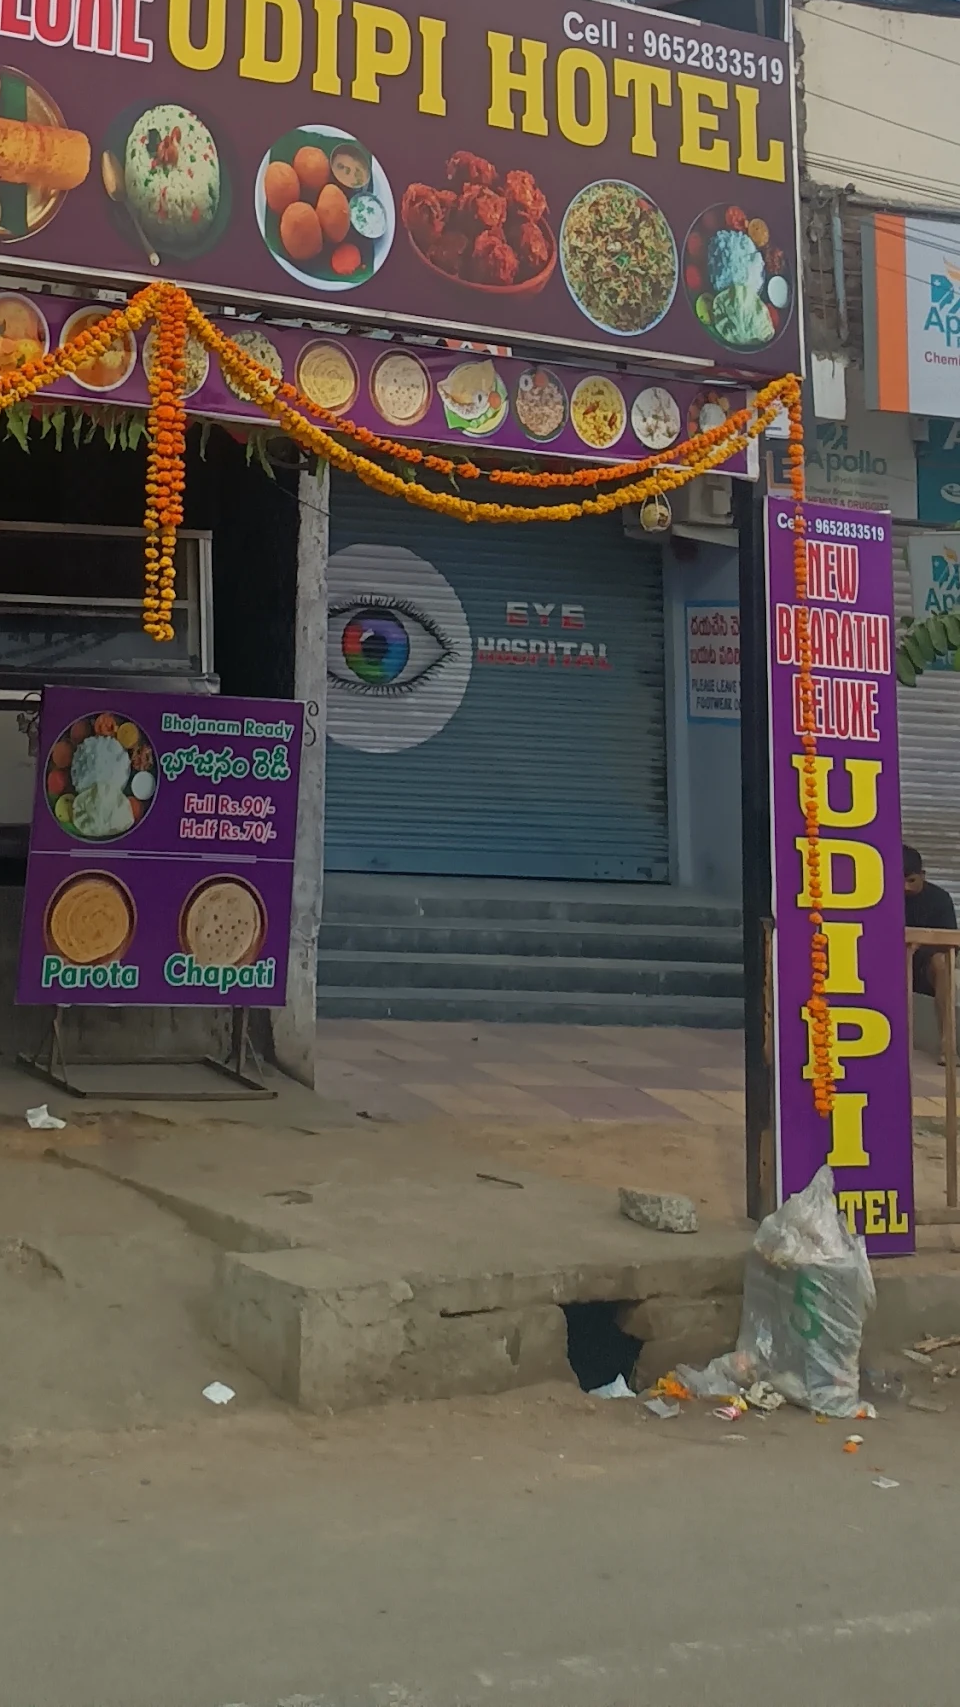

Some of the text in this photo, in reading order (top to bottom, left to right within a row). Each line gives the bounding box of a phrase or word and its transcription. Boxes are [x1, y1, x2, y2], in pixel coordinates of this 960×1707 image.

[563, 11, 617, 49] Cell
[643, 30, 784, 85] 9652833519
[486, 30, 787, 183] HOTEL
[777, 513, 804, 533] Ce
[815, 518, 885, 542] 9652833519
[806, 539, 859, 604] NEW
[505, 601, 586, 630] EYE
[476, 636, 613, 670] HOSPITAL
[162, 713, 295, 742] Bhojanam Ready
[184, 793, 276, 819] Full Rs.90/-
[180, 818, 277, 844] Half Rs.70/-
[42, 952, 276, 994] Parota Chapati
